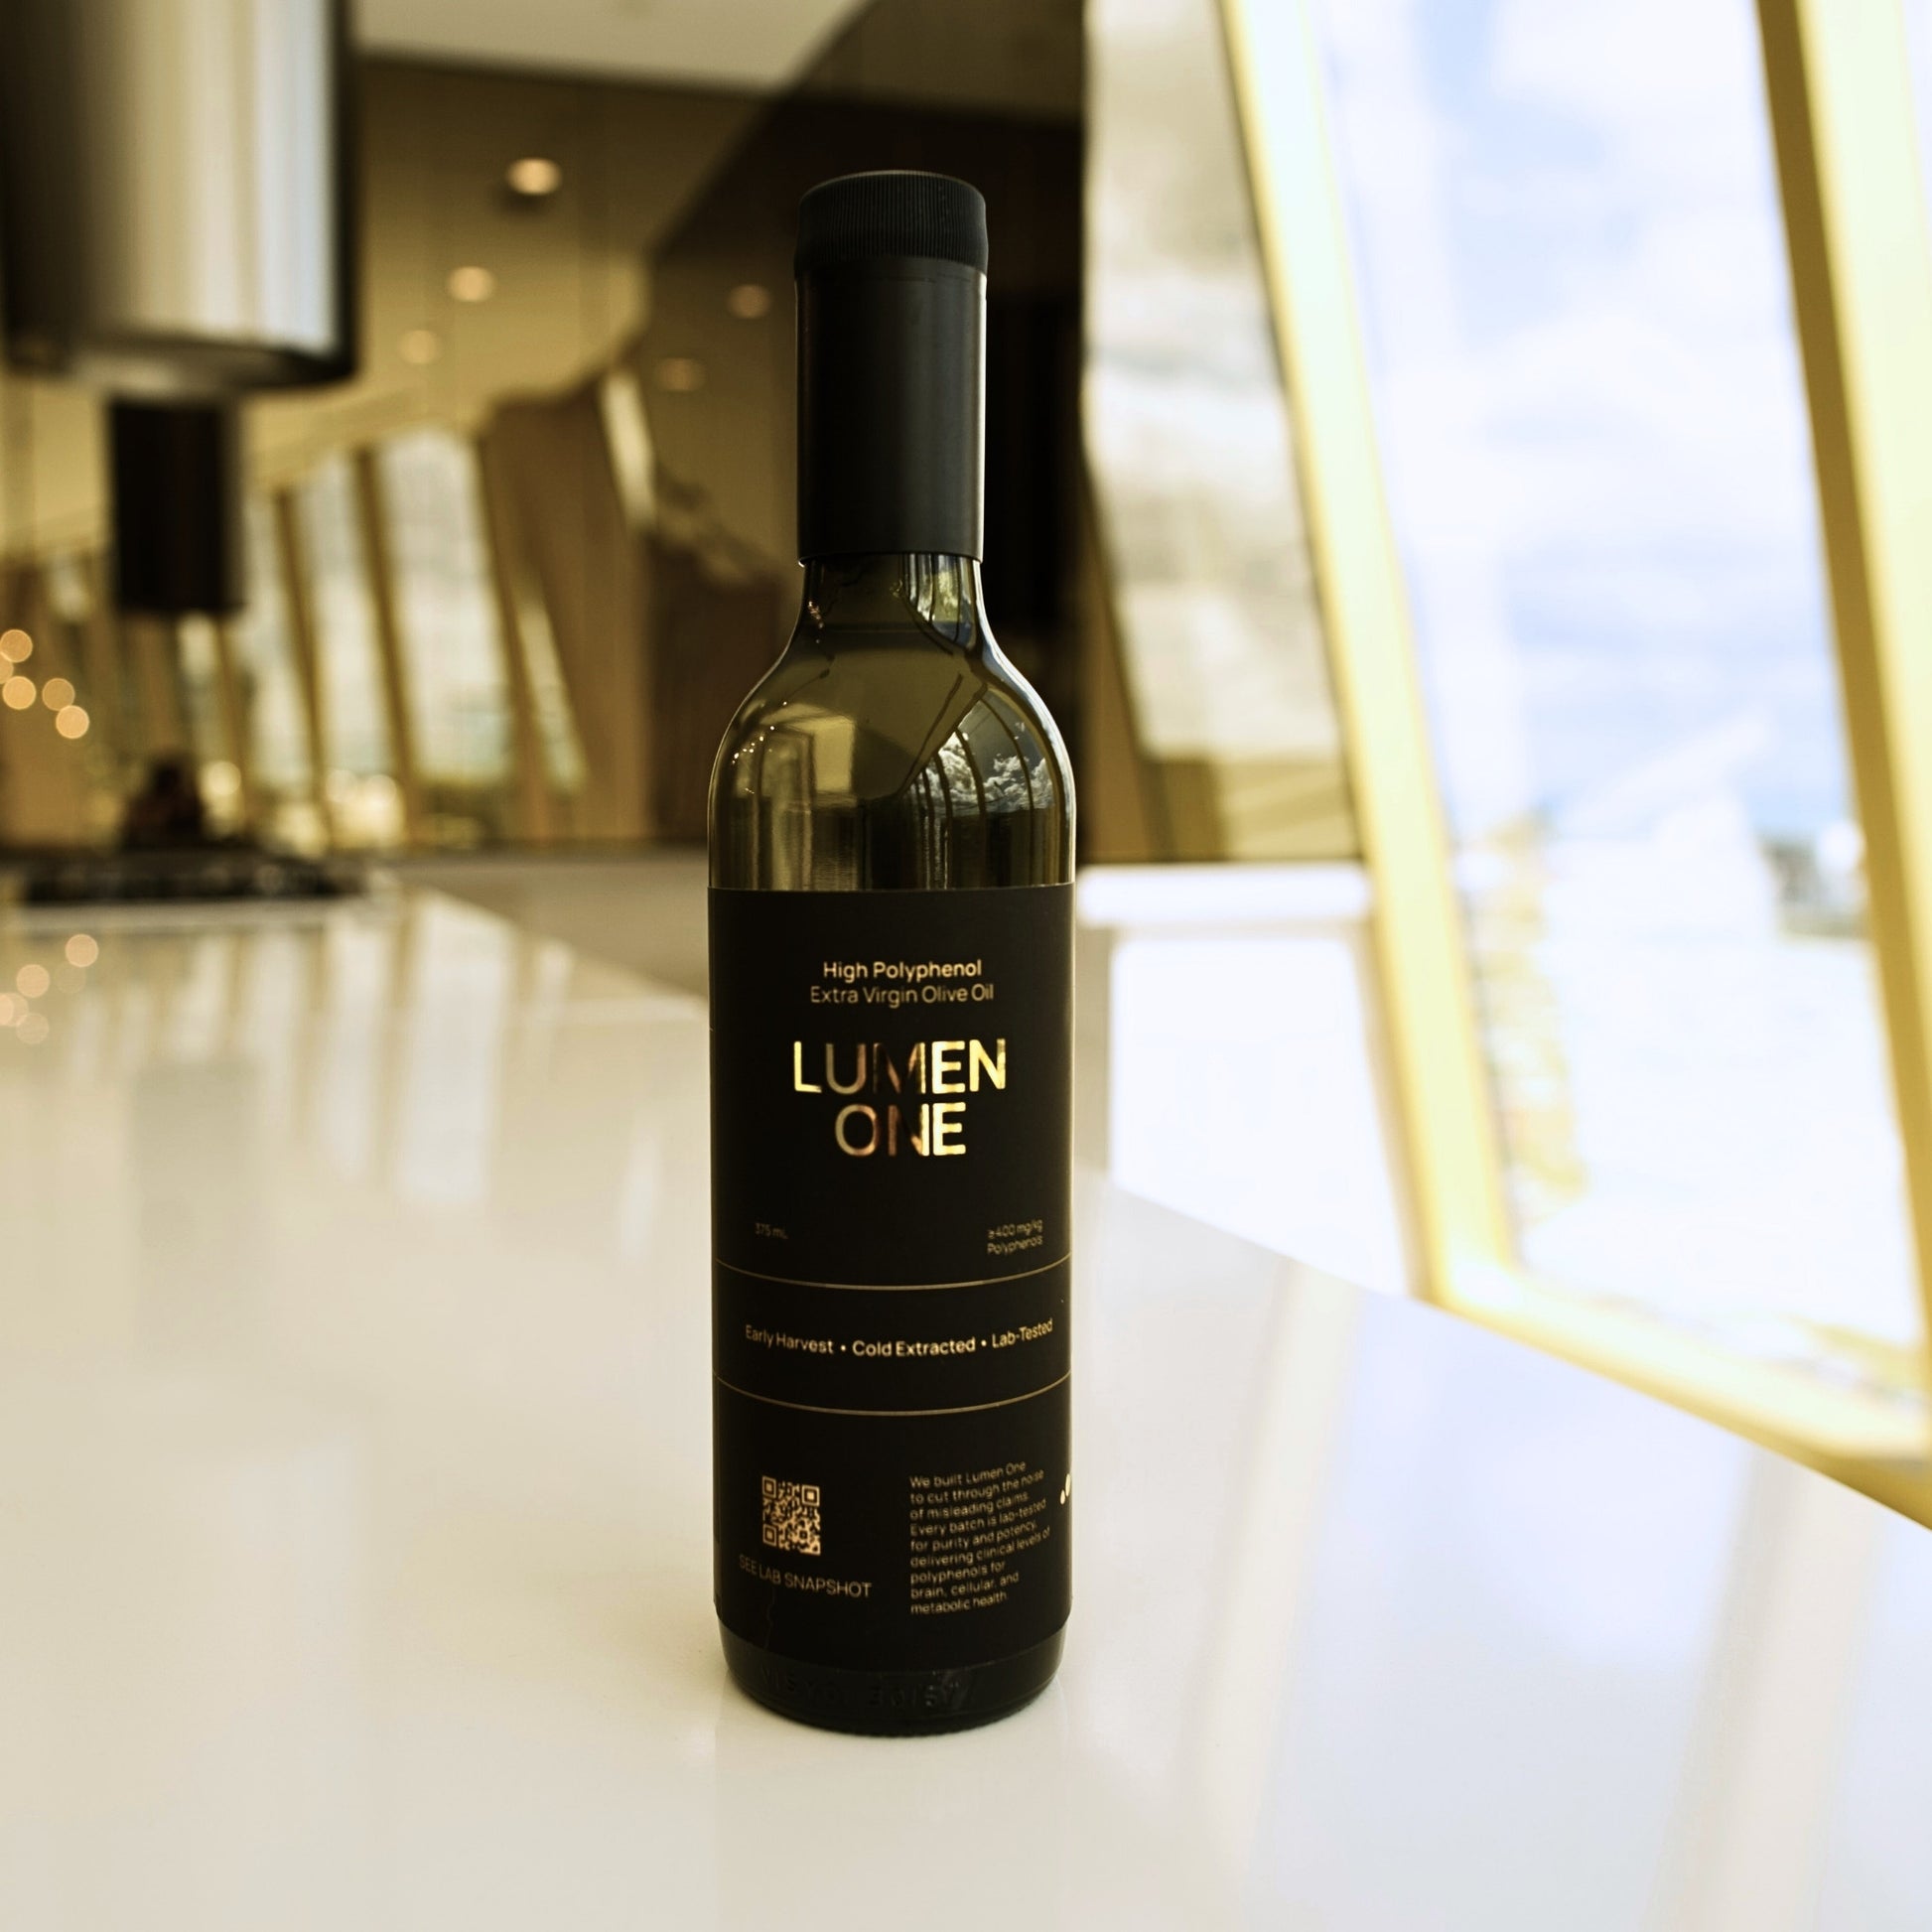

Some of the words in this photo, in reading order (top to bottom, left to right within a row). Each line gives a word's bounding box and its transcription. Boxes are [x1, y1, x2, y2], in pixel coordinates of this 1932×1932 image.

[824, 962, 868, 983] High
[873, 960, 981, 982] Polyphenol
[811, 986, 858, 1004] Extra
[863, 986, 917, 1008] Virgin
[922, 985, 968, 1003] Olive
[971, 984, 994, 1001] Oil
[794, 1038, 1006, 1094] LUMEN
[835, 1102, 966, 1157] ONE
[745, 1325, 773, 1349] Early
[776, 1333, 833, 1354] Harvest
[853, 1340, 892, 1356] Cold
[896, 1339, 976, 1356] Extracted
[992, 1318, 1053, 1348] Lab-Tested
[909, 1476, 930, 1488] We
[934, 1474, 962, 1487] built
[966, 1467, 1003, 1483] Lumen
[1006, 1461, 1026, 1475] One
[911, 1493, 924, 1504] to
[927, 1491, 948, 1502] cut
[953, 1485, 1000, 1500] through
[1002, 1479, 1019, 1491] the
[1021, 1469, 1044, 1485] noise
[910, 1509, 924, 1520] of
[927, 1501, 994, 1518] misleading
[910, 1523, 946, 1537] Every
[950, 1518, 984, 1533] batch
[988, 1514, 996, 1526] is
[910, 1540, 928, 1551] for
[933, 1537, 969, 1552] purity
[972, 1531, 994, 1544] and
[911, 1552, 973, 1568] delivering
[976, 1543, 1014, 1560] clinical
[1017, 1532, 1041, 1550] levels
[1043, 1526, 1050, 1539] of
[739, 1553, 757, 1575] SEE
[759, 1564, 781, 1585] LAB
[784, 1572, 872, 1598] SNAPSHOT
[911, 1564, 988, 1584] polyphenols
[991, 1561, 1005, 1573] for
[1000, 1571, 1019, 1586] and
[911, 1598, 970, 1615] metabolic
